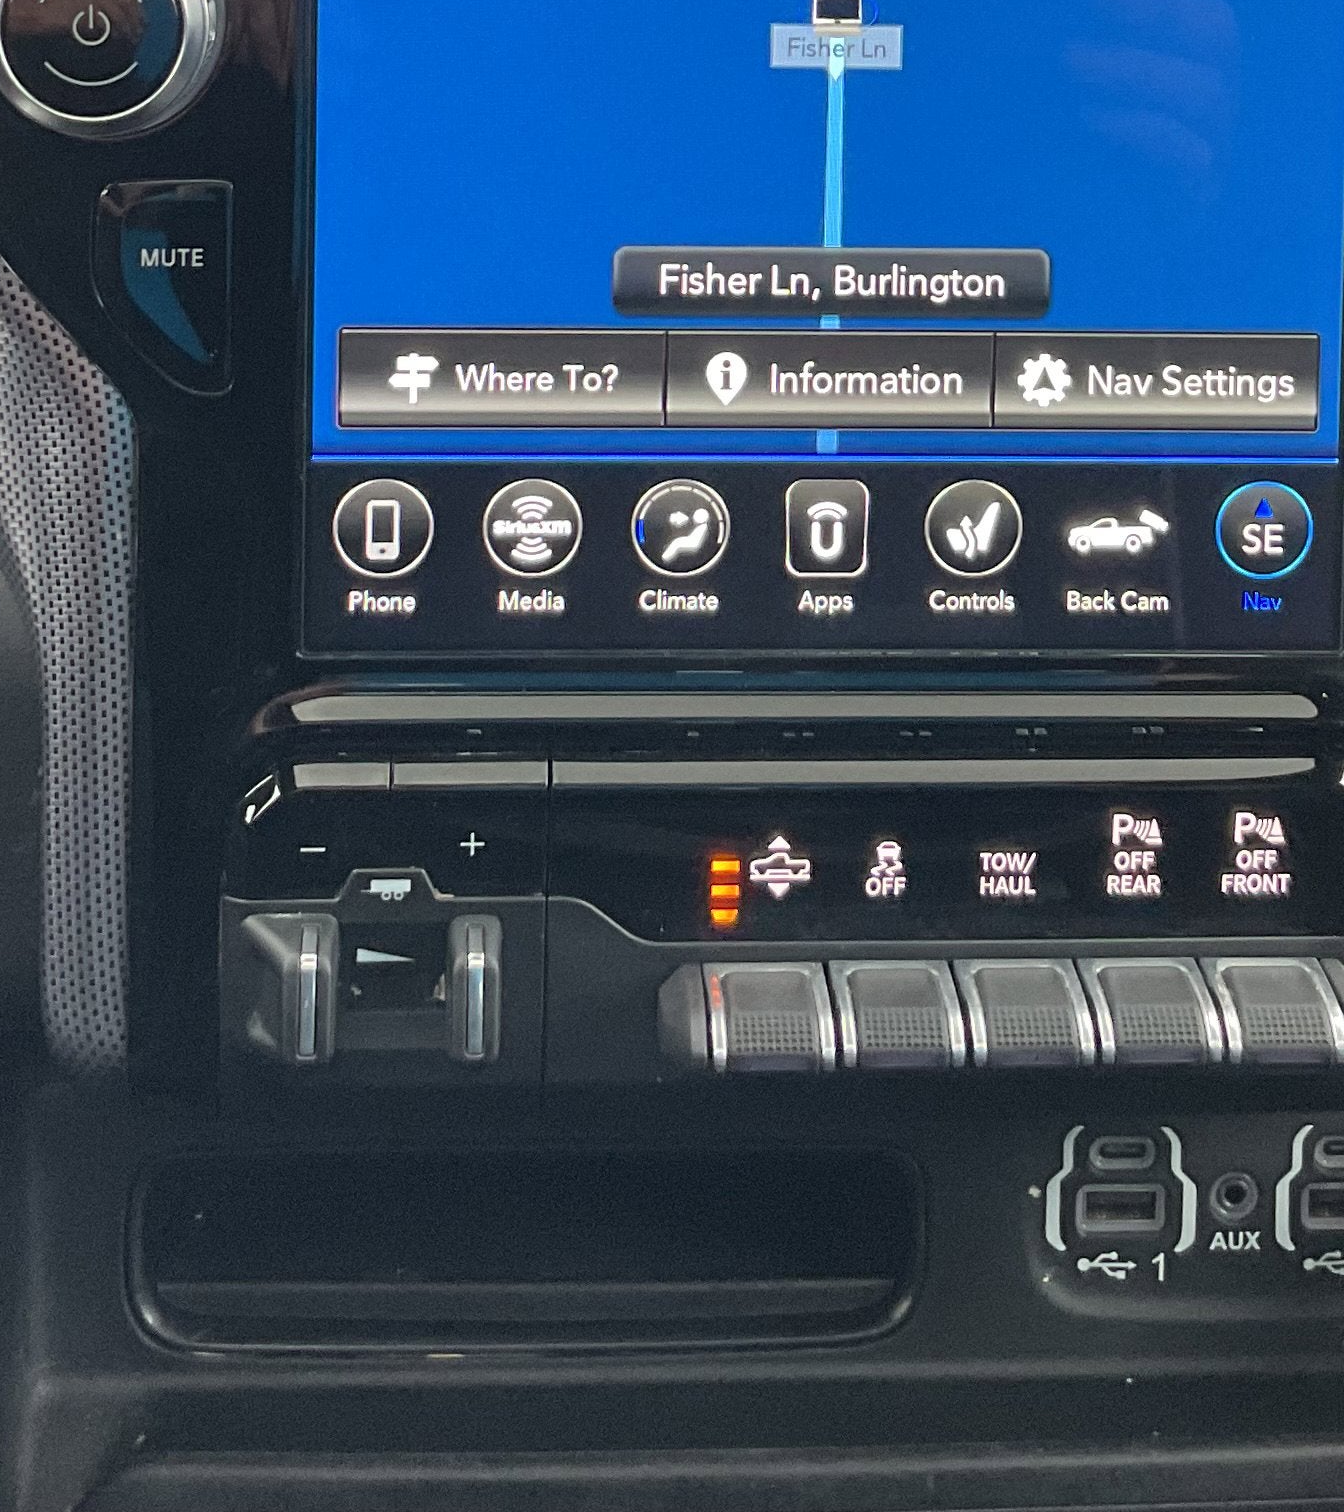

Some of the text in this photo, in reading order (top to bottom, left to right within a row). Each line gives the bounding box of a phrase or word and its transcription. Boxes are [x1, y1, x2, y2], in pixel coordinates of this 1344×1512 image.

[788, 37, 886, 58] Fisher Ln
[141, 249, 204, 268] MUTE
[659, 263, 1006, 302] Fisher Ln, Burlington
[455, 364, 619, 393] Where To?
[770, 362, 962, 394] Information
[1087, 365, 1295, 402] Nav Settings
[1241, 524, 1284, 556] SE
[348, 591, 416, 613] Phone
[498, 591, 565, 612] Media
[639, 591, 718, 612] Climate
[798, 592, 853, 616] Apps
[929, 591, 1014, 611] Controls
[1066, 591, 1169, 611] Back Cam
[1243, 592, 1281, 610] Nav
[980, 853, 1036, 873] TOW/
[1114, 852, 1154, 872] OFF
[1236, 851, 1277, 870] OFF
[865, 877, 906, 897] OFF
[979, 877, 1035, 897] HAUL
[1107, 876, 1160, 894] REAR
[1221, 875, 1290, 895] FRONT
[1210, 1231, 1260, 1251] AUX
[1152, 1253, 1166, 1282] 1
